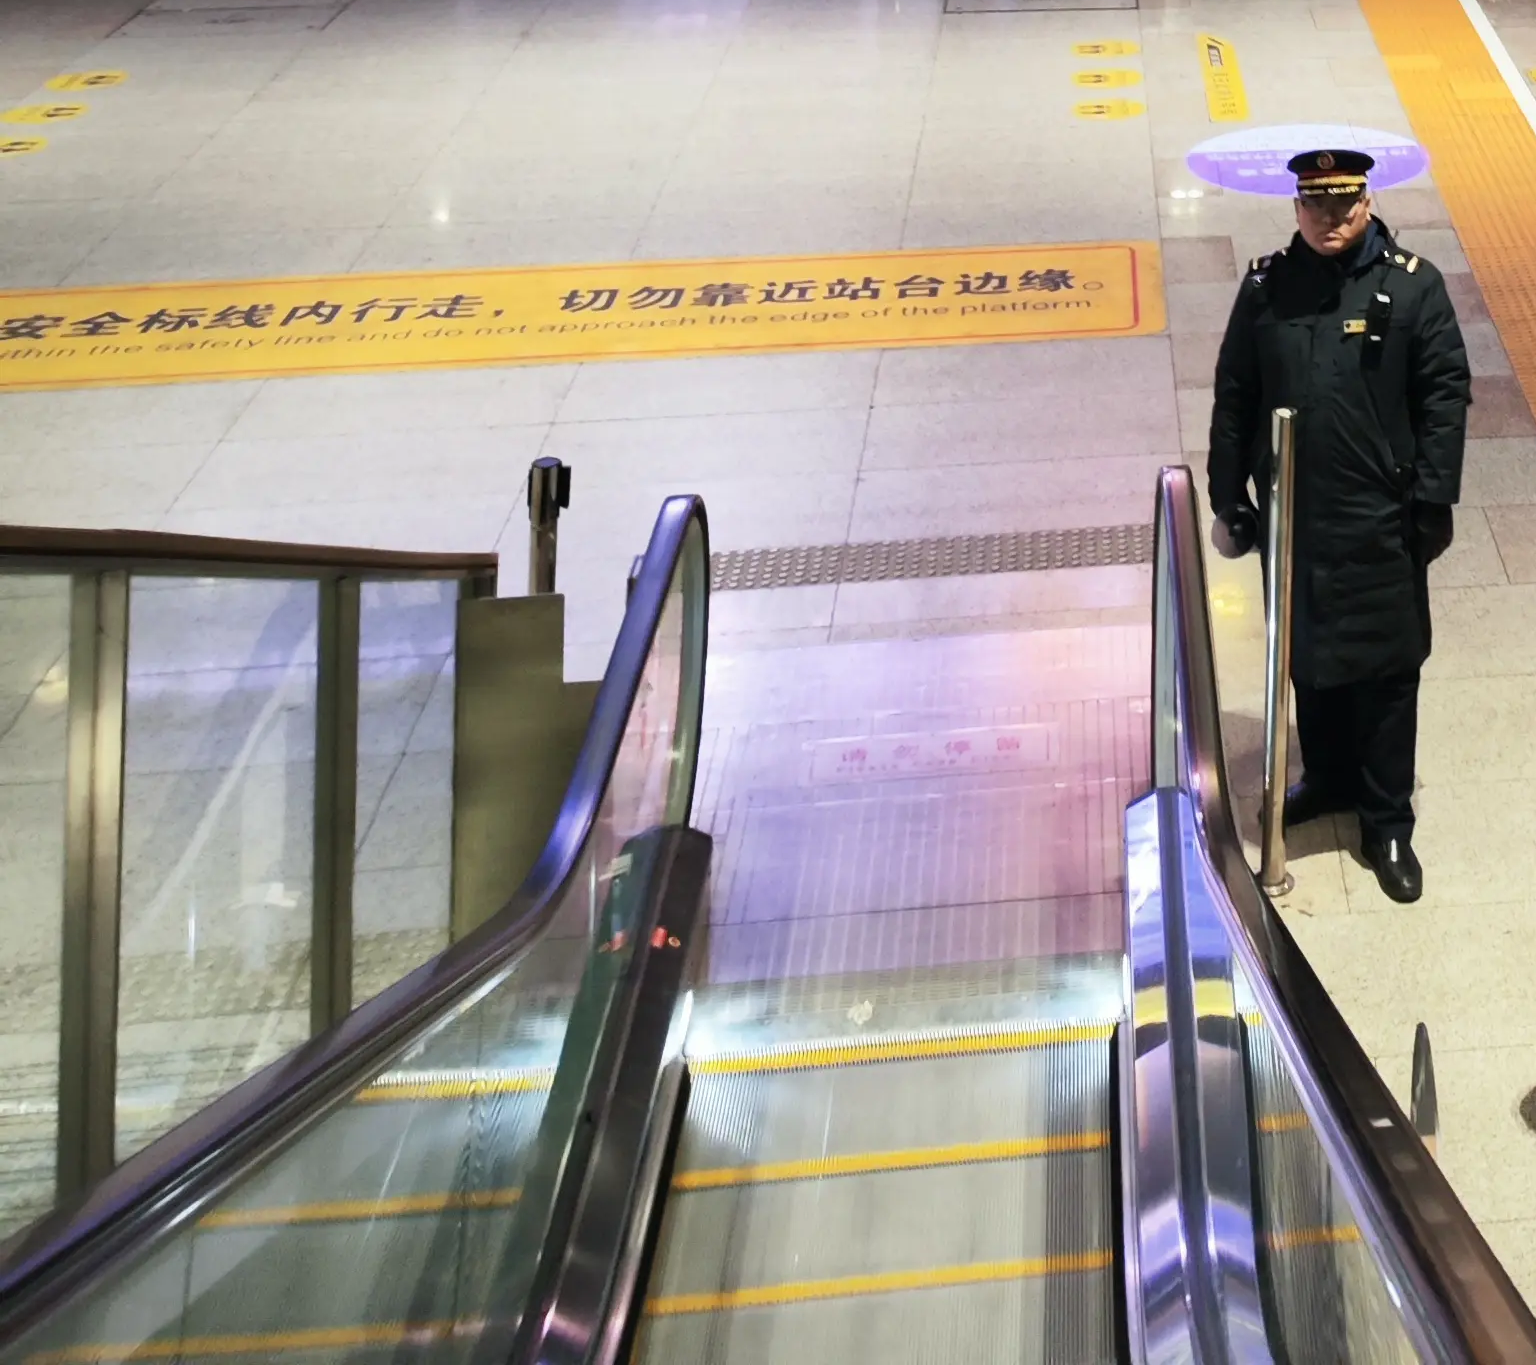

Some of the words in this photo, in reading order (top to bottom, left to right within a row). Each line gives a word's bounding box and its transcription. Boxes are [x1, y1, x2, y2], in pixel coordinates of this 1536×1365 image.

[89, 344, 143, 356] the
[155, 336, 265, 352] safety
[273, 334, 336, 346] line
[346, 328, 412, 343] and
[422, 326, 463, 339] do
[474, 324, 528, 335] not
[538, 316, 697, 333] approach
[708, 314, 758, 325] the
[769, 311, 851, 323] edge
[861, 306, 893, 319] of
[901, 304, 950, 317] the
